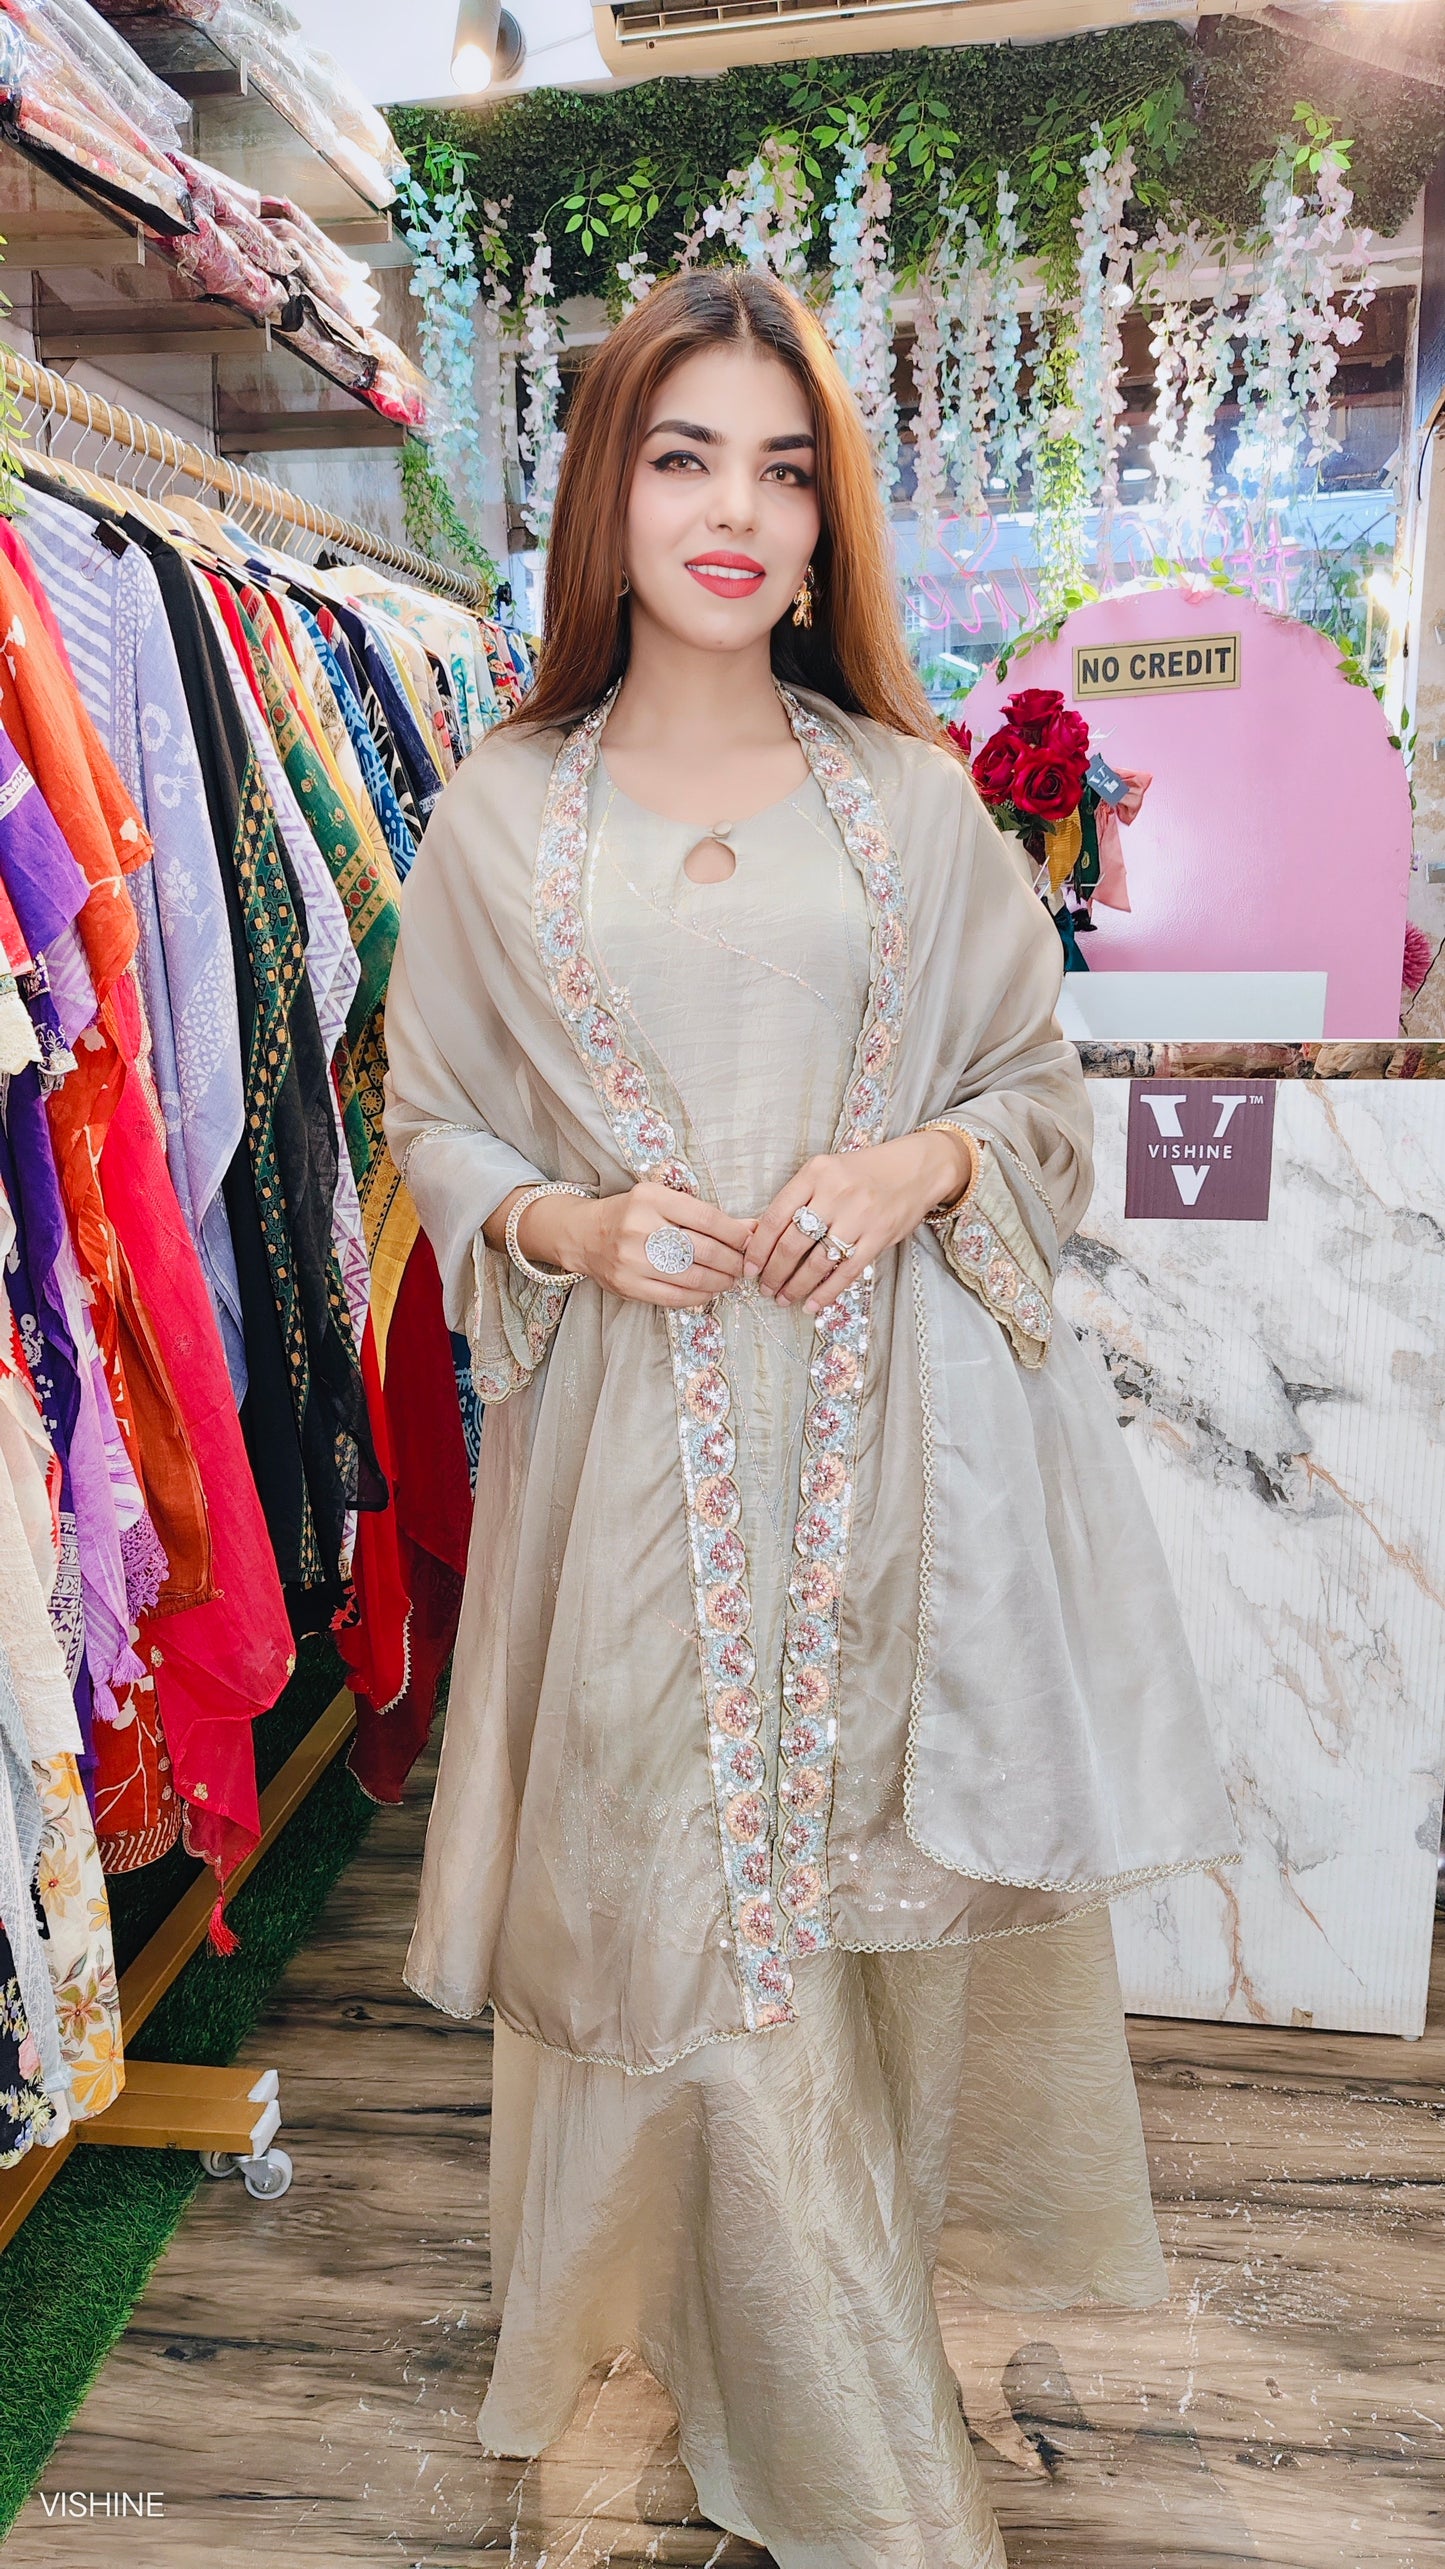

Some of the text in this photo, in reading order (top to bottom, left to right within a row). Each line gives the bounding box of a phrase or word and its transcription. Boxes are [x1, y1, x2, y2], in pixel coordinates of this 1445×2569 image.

[1082, 647, 1231, 684] NO CREDIT
[1148, 1144, 1233, 1159] VISHINE
